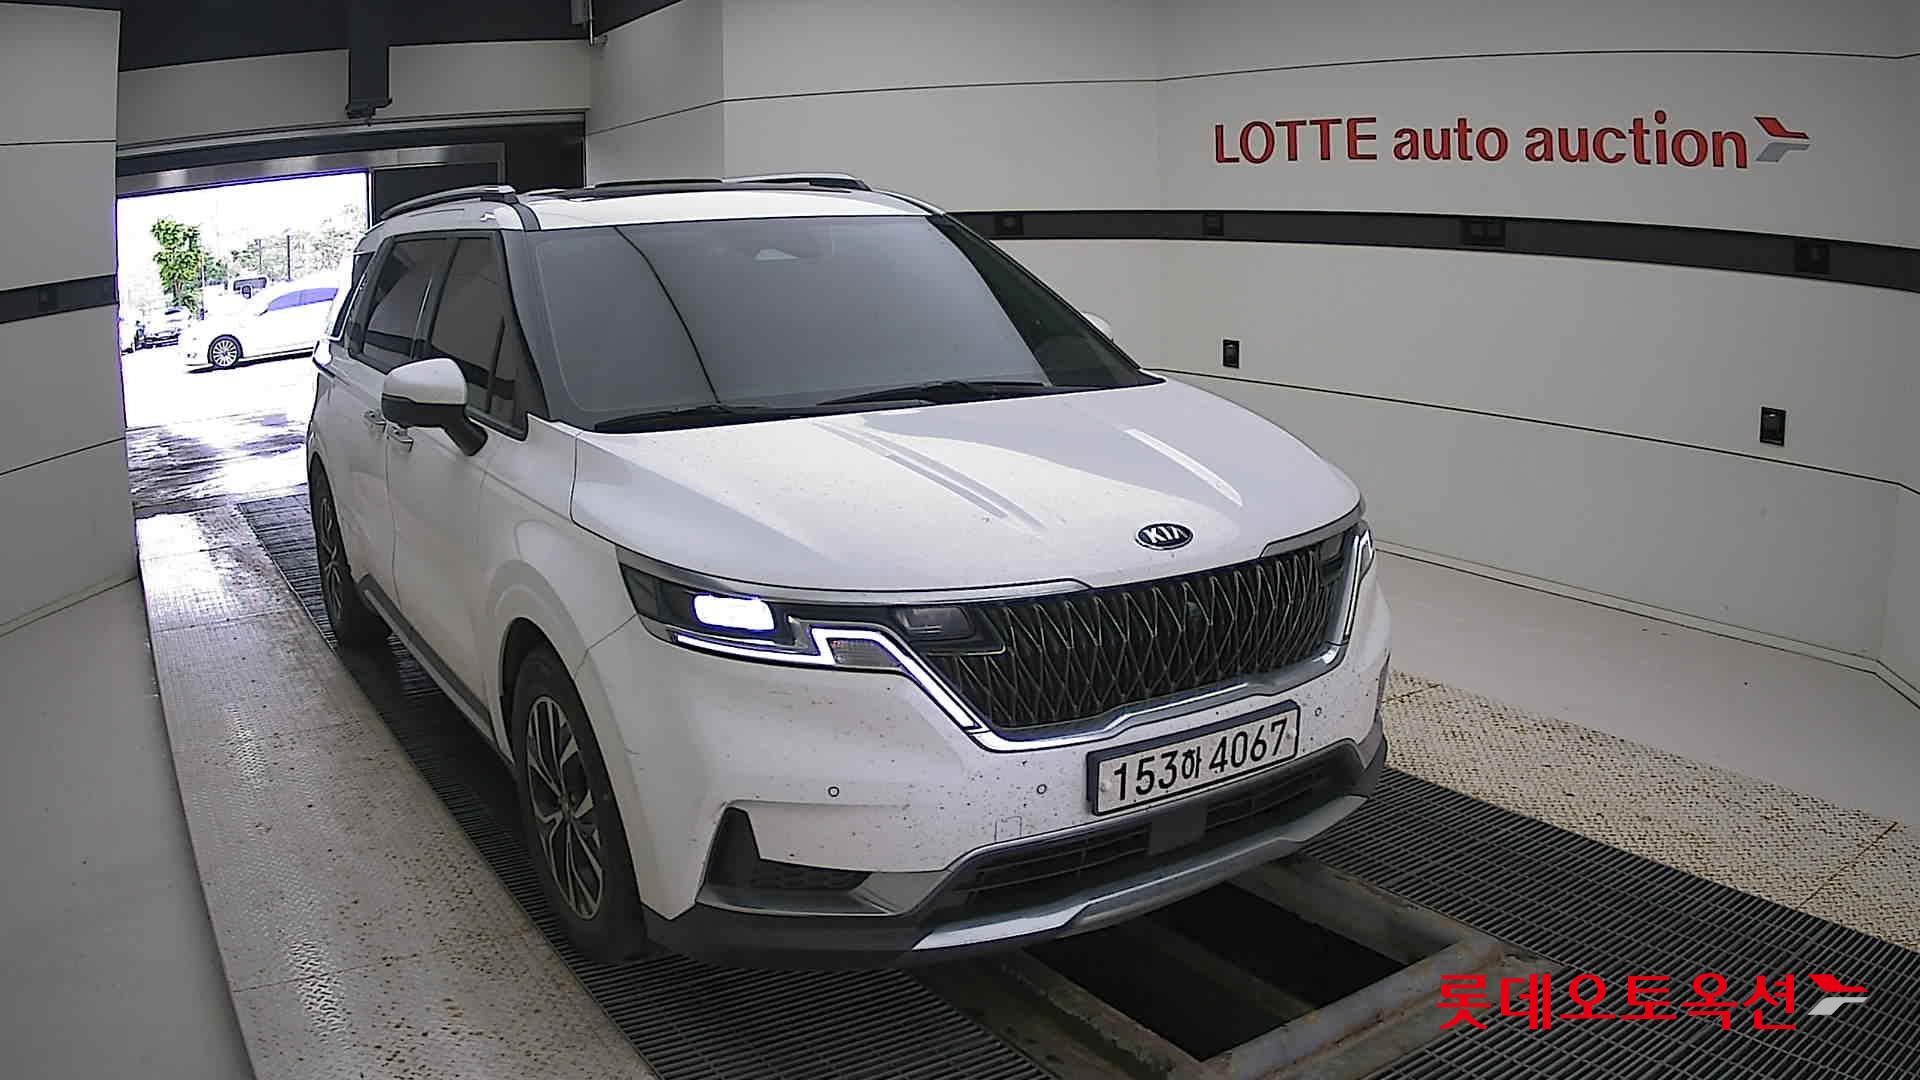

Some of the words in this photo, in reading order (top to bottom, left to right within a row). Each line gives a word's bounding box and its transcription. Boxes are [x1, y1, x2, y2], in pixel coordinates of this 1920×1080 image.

[1215, 117, 1377, 163] LOTTE
[1393, 118, 1508, 161] auto
[1525, 110, 1748, 168] auction
[1140, 526, 1188, 544] KIA
[1113, 746, 1202, 801] 153하
[1208, 717, 1288, 774] 4067
